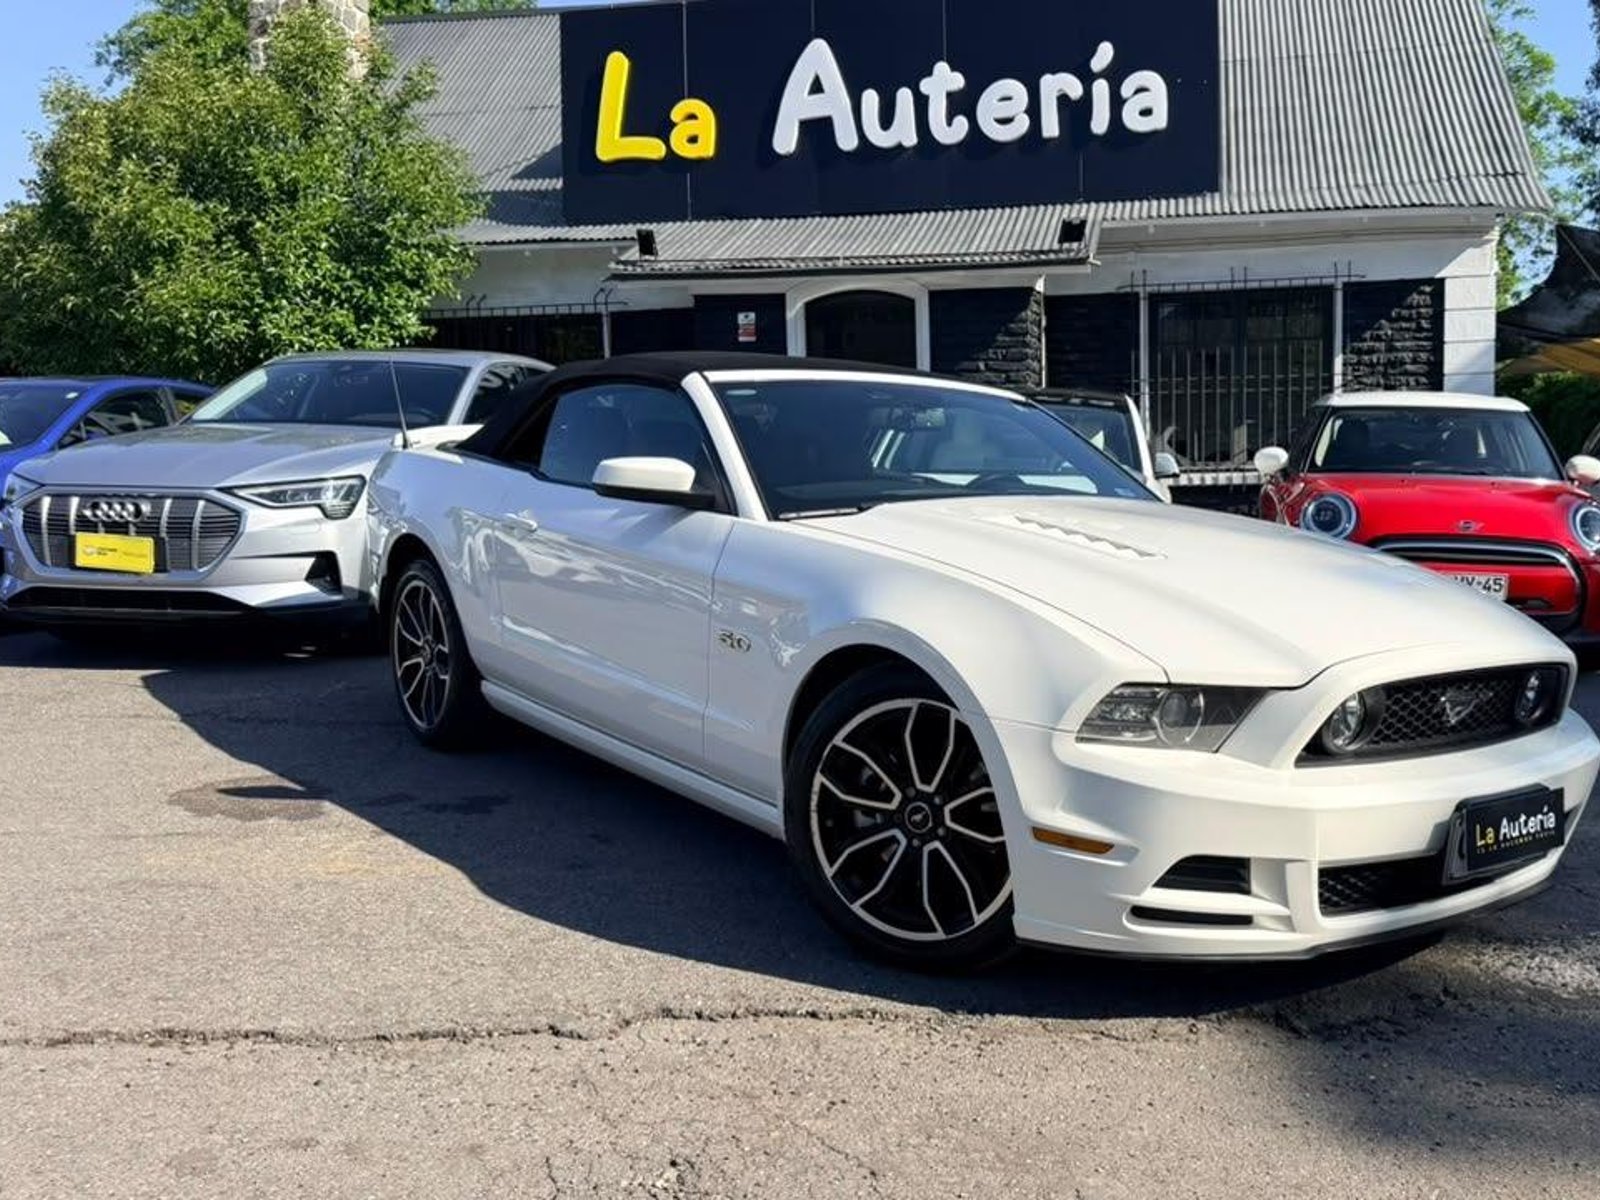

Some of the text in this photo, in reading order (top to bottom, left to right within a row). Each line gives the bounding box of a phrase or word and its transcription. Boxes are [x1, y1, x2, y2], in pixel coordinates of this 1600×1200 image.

[595, 38, 1169, 161] La Autería
[1475, 823, 1495, 847] La
[1499, 804, 1556, 841] Autería
